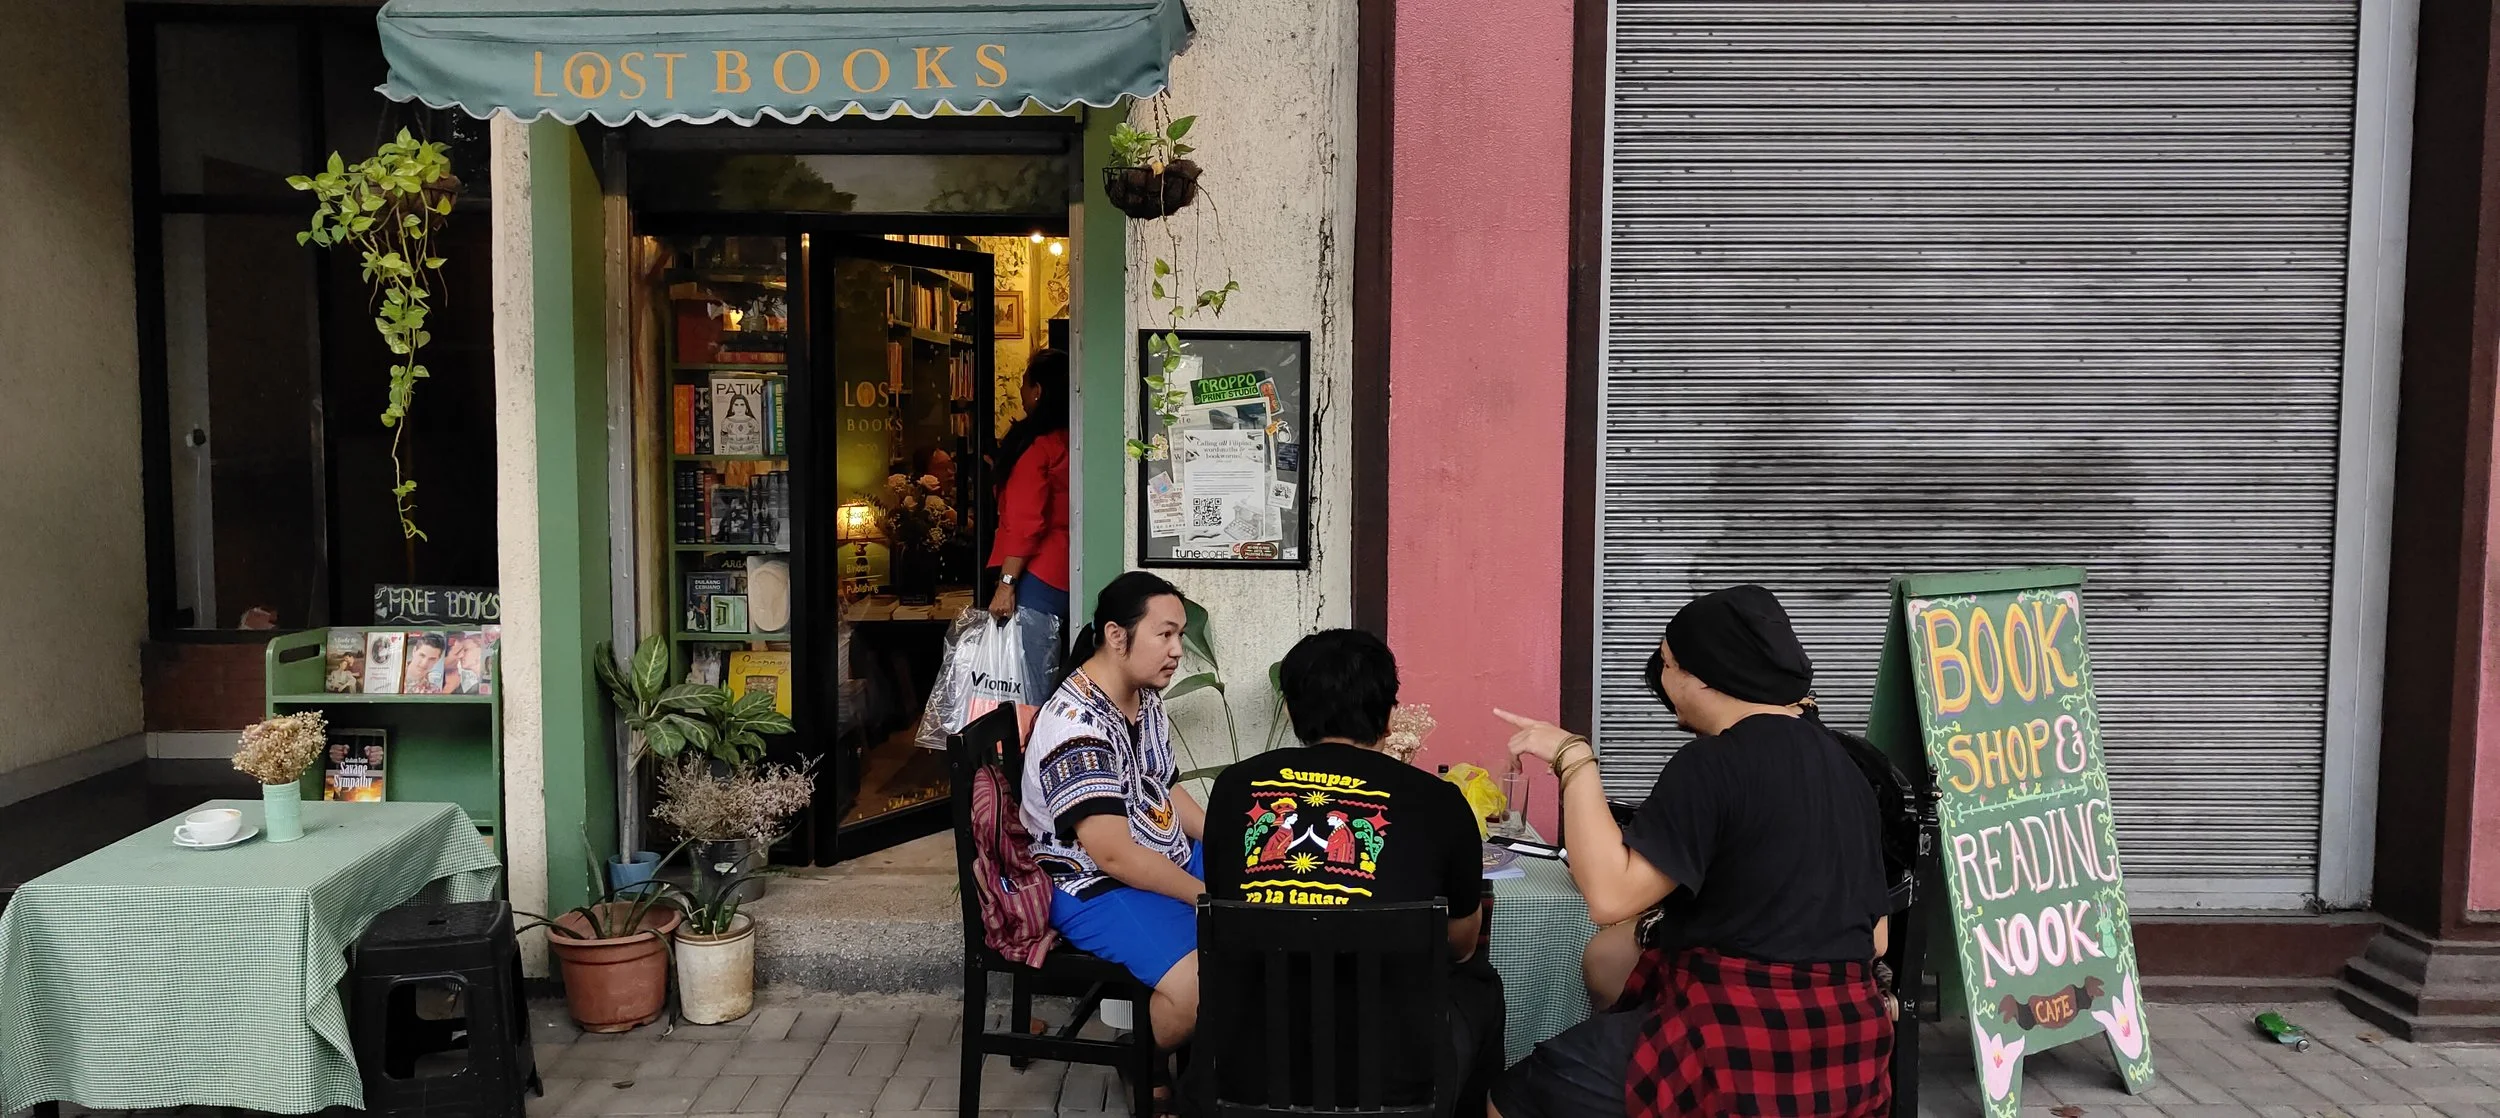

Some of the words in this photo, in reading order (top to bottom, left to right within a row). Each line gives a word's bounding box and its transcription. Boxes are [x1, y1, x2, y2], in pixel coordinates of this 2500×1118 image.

[532, 50, 688, 100] LOST
[711, 44, 1009, 95] BOOKS
[844, 380, 904, 408] LOST
[1198, 373, 1256, 393] TROPPO
[1202, 391, 1227, 402] PRINT
[1228, 385, 1259, 398] STUDIO
[847, 418, 904, 432] BOOKS
[846, 583, 879, 594] Publishing
[387, 588, 439, 616] FREE
[445, 591, 500, 620] BOOKS
[1918, 601, 2079, 719] BOOK
[971, 671, 1021, 694] Viomix
[1947, 718, 2050, 793] SHOP
[2053, 714, 2087, 774] &
[340, 761, 368, 776] Savage
[1279, 767, 1367, 789] Sumpay
[333, 774, 373, 790] Sympathy
[1952, 798, 2118, 910] READING
[1972, 899, 2106, 988] NOOK
[2034, 994, 2074, 1024] CAFE
